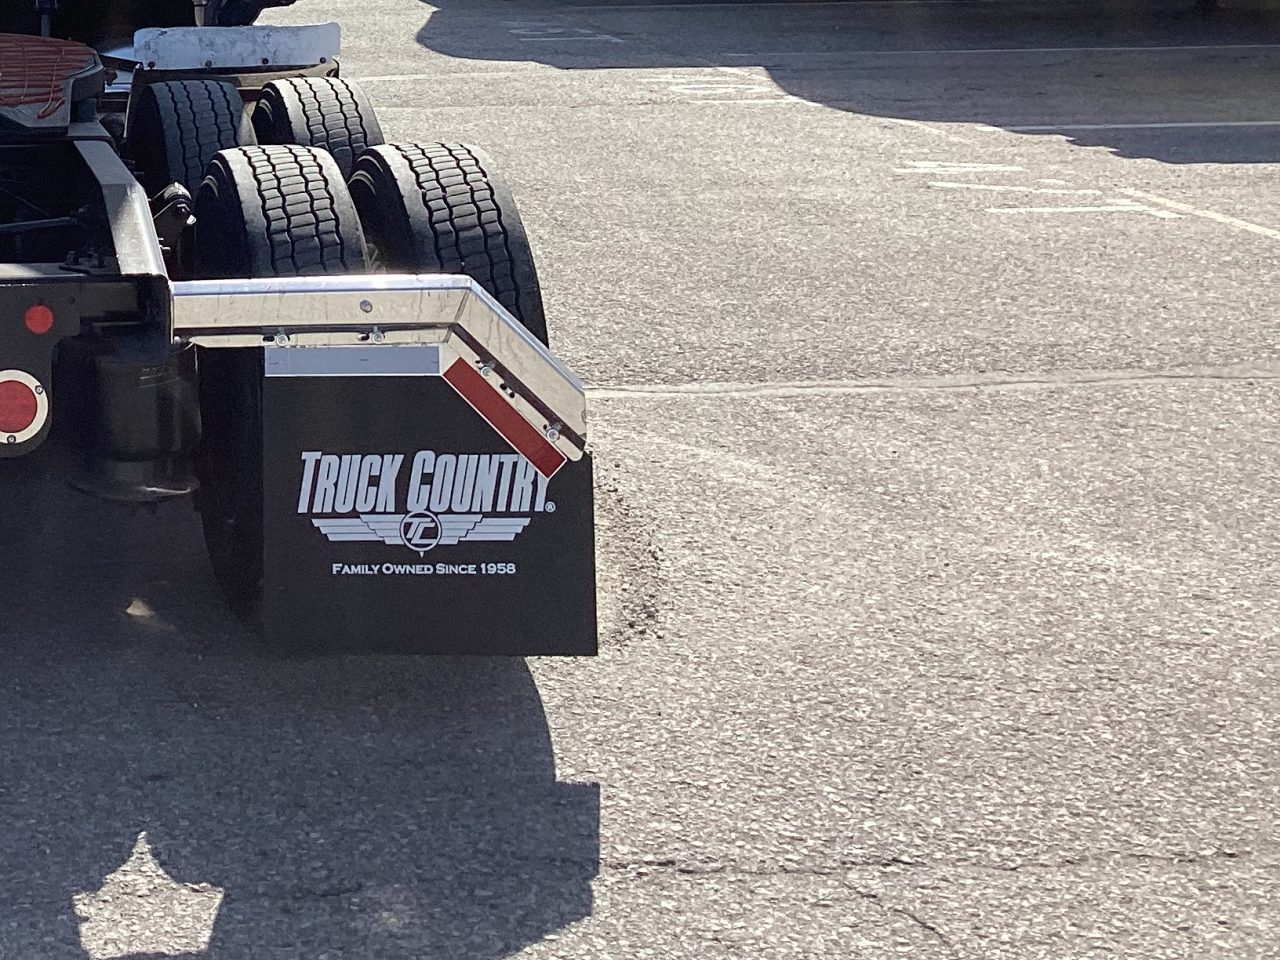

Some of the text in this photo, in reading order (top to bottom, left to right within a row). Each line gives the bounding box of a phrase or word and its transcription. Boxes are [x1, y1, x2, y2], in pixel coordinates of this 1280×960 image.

[297, 451, 404, 514] TRUCK
[332, 562, 517, 576] FAMILY OWNED SINCE 1958
